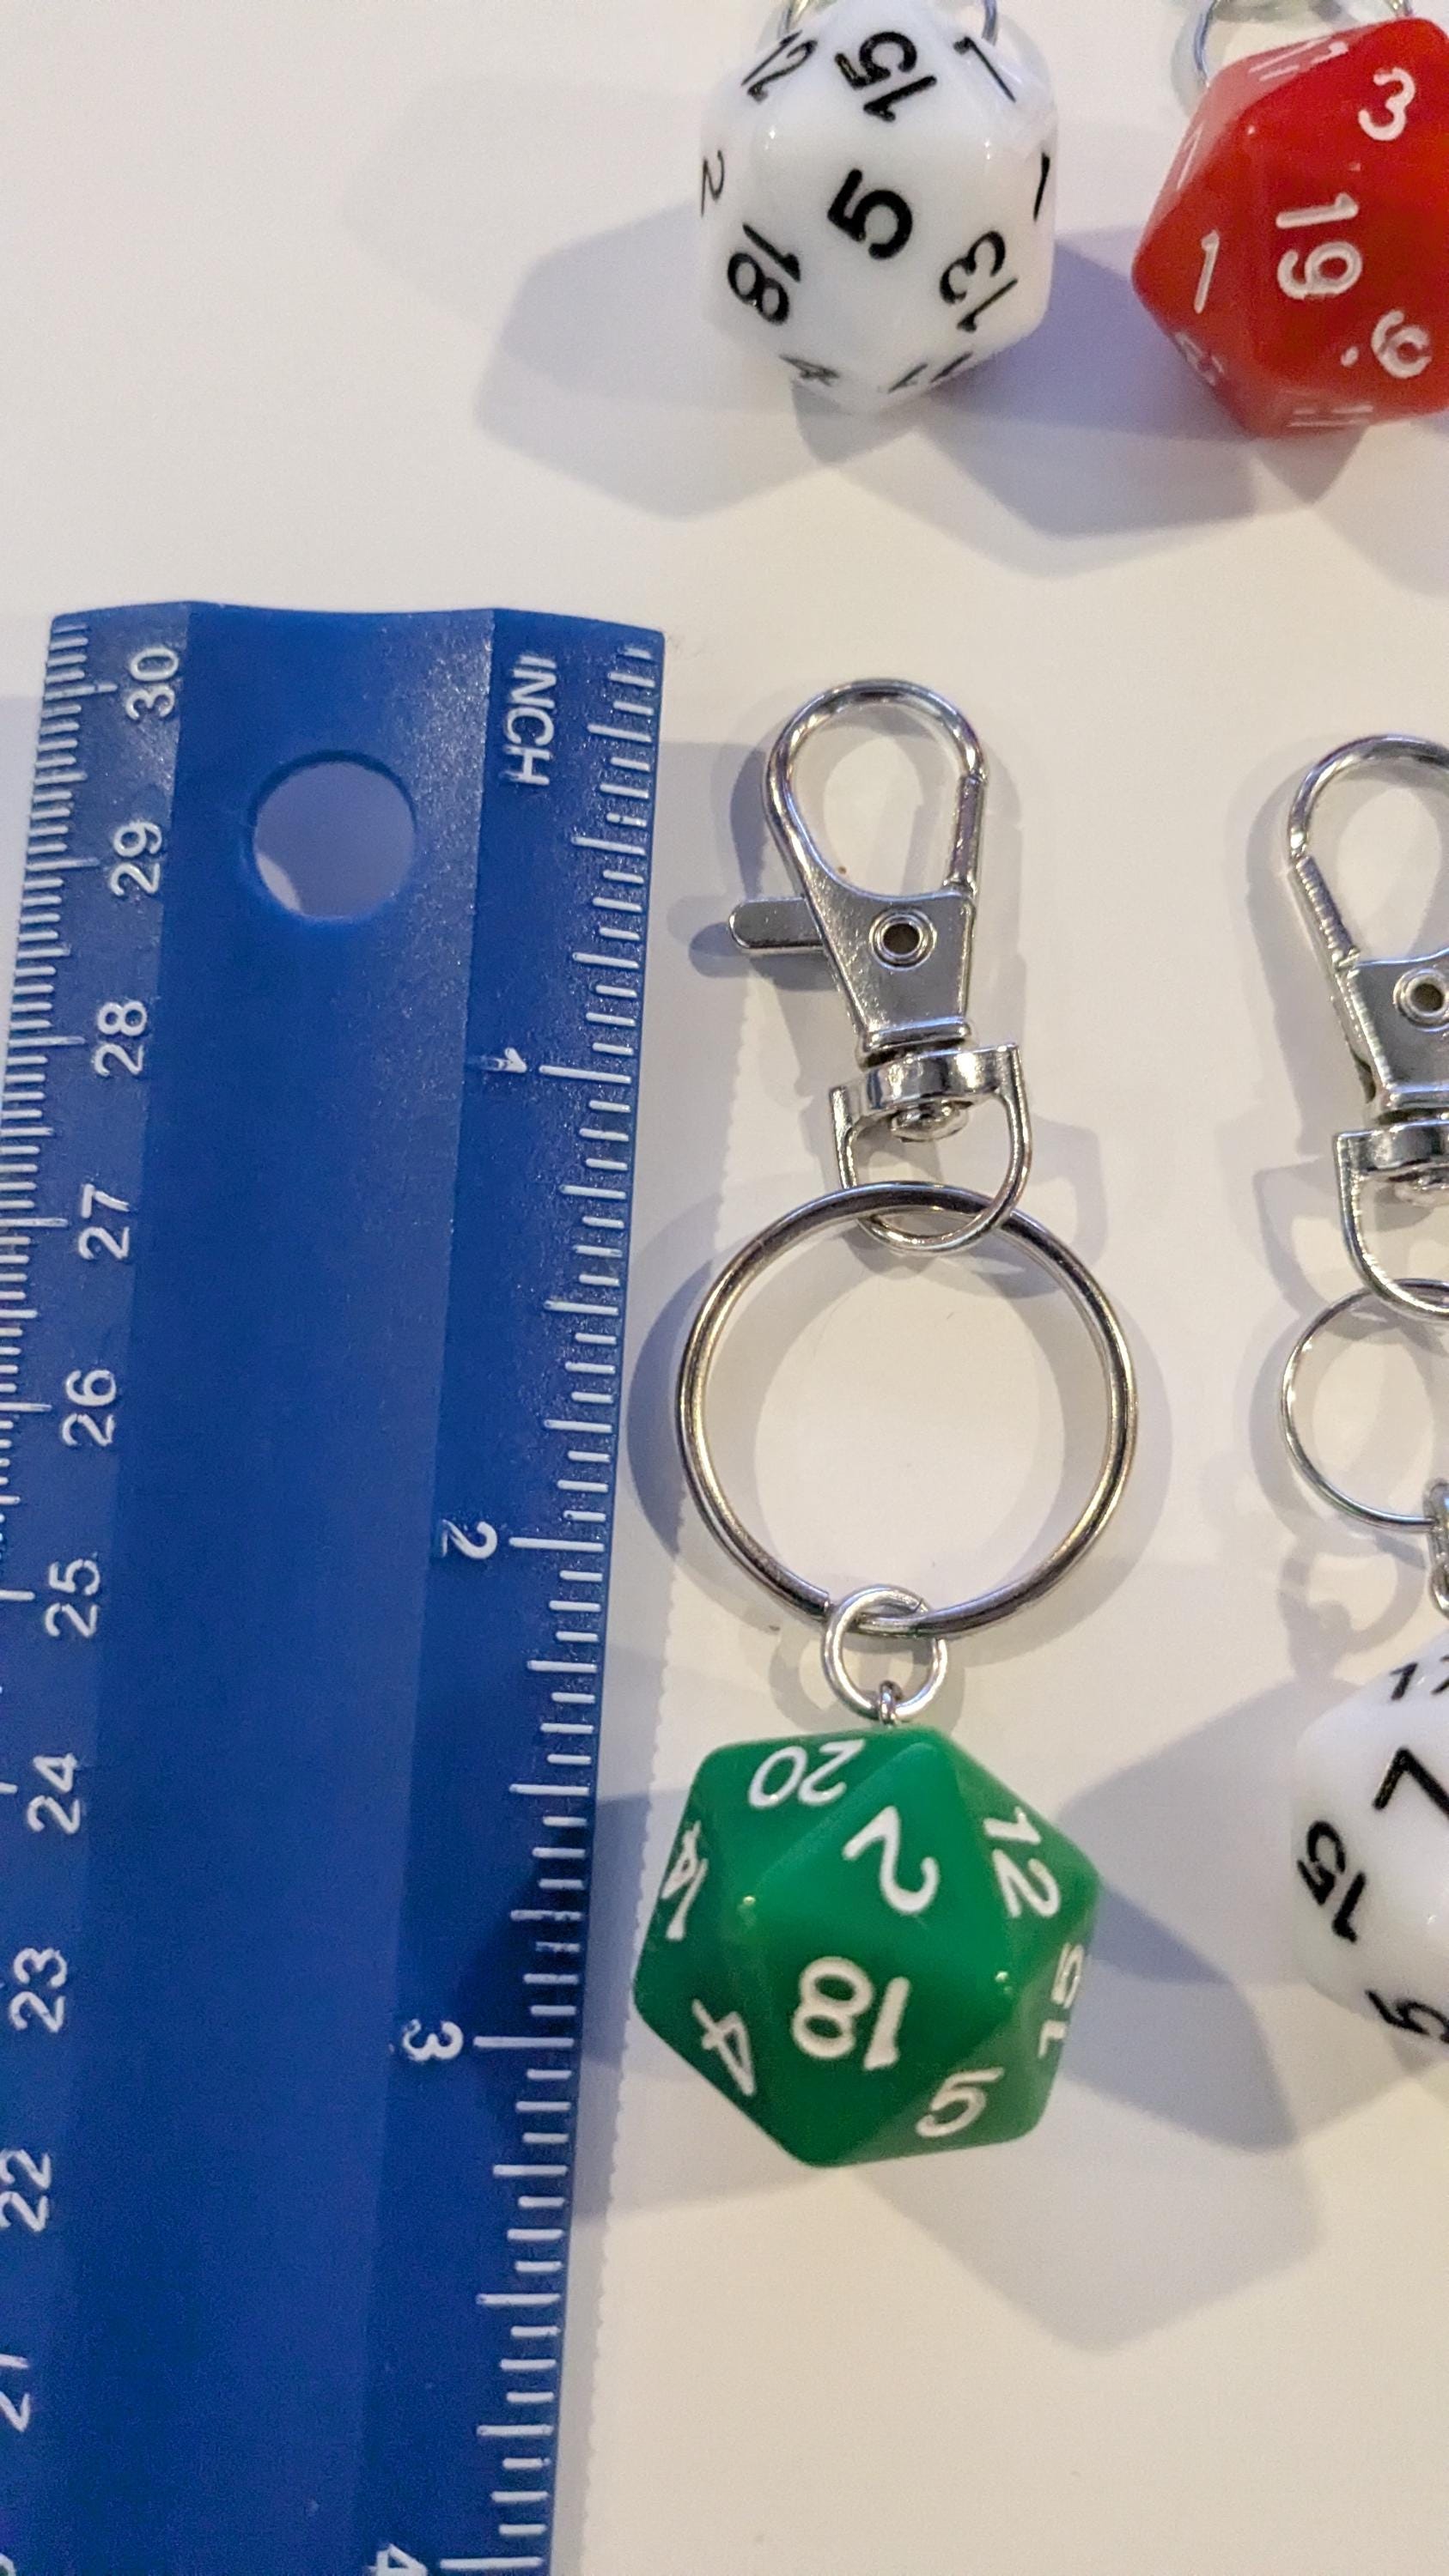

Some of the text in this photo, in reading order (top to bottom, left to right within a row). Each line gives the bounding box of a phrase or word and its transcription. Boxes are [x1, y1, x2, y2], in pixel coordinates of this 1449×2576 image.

[742, 31, 818, 101] 12
[835, 32, 937, 122] 15
[1358, 67, 1416, 142] 3
[827, 168, 912, 260] 5
[1275, 192, 1363, 299] 19
[727, 222, 801, 325] 18
[939, 230, 1019, 333] 13
[1194, 229, 1220, 314] 1
[125, 645, 179, 721] 30
[505, 654, 557, 786] INCH
[109, 820, 162, 897] 29
[94, 999, 148, 1078] 28
[481, 1047, 527, 1073] 1
[79, 1182, 133, 1261] 27
[62, 1370, 117, 1448] 26
[441, 1521, 498, 1560] 2
[45, 1558, 101, 1638] 25
[27, 1753, 80, 1834] 24
[748, 1738, 866, 1807] 20
[661, 1820, 709, 1941] 14
[843, 1806, 941, 1916] 2
[983, 1807, 1061, 1918] 12
[1297, 1820, 1367, 1944] 15
[9, 1947, 67, 2034] 23
[791, 1955, 911, 2072] 18
[1038, 1942, 1084, 2059] 15
[401, 2020, 464, 2062] 3
[691, 1997, 756, 2097] 4
[915, 2068, 1005, 2138] 5
[0, 2148, 52, 2233] 22
